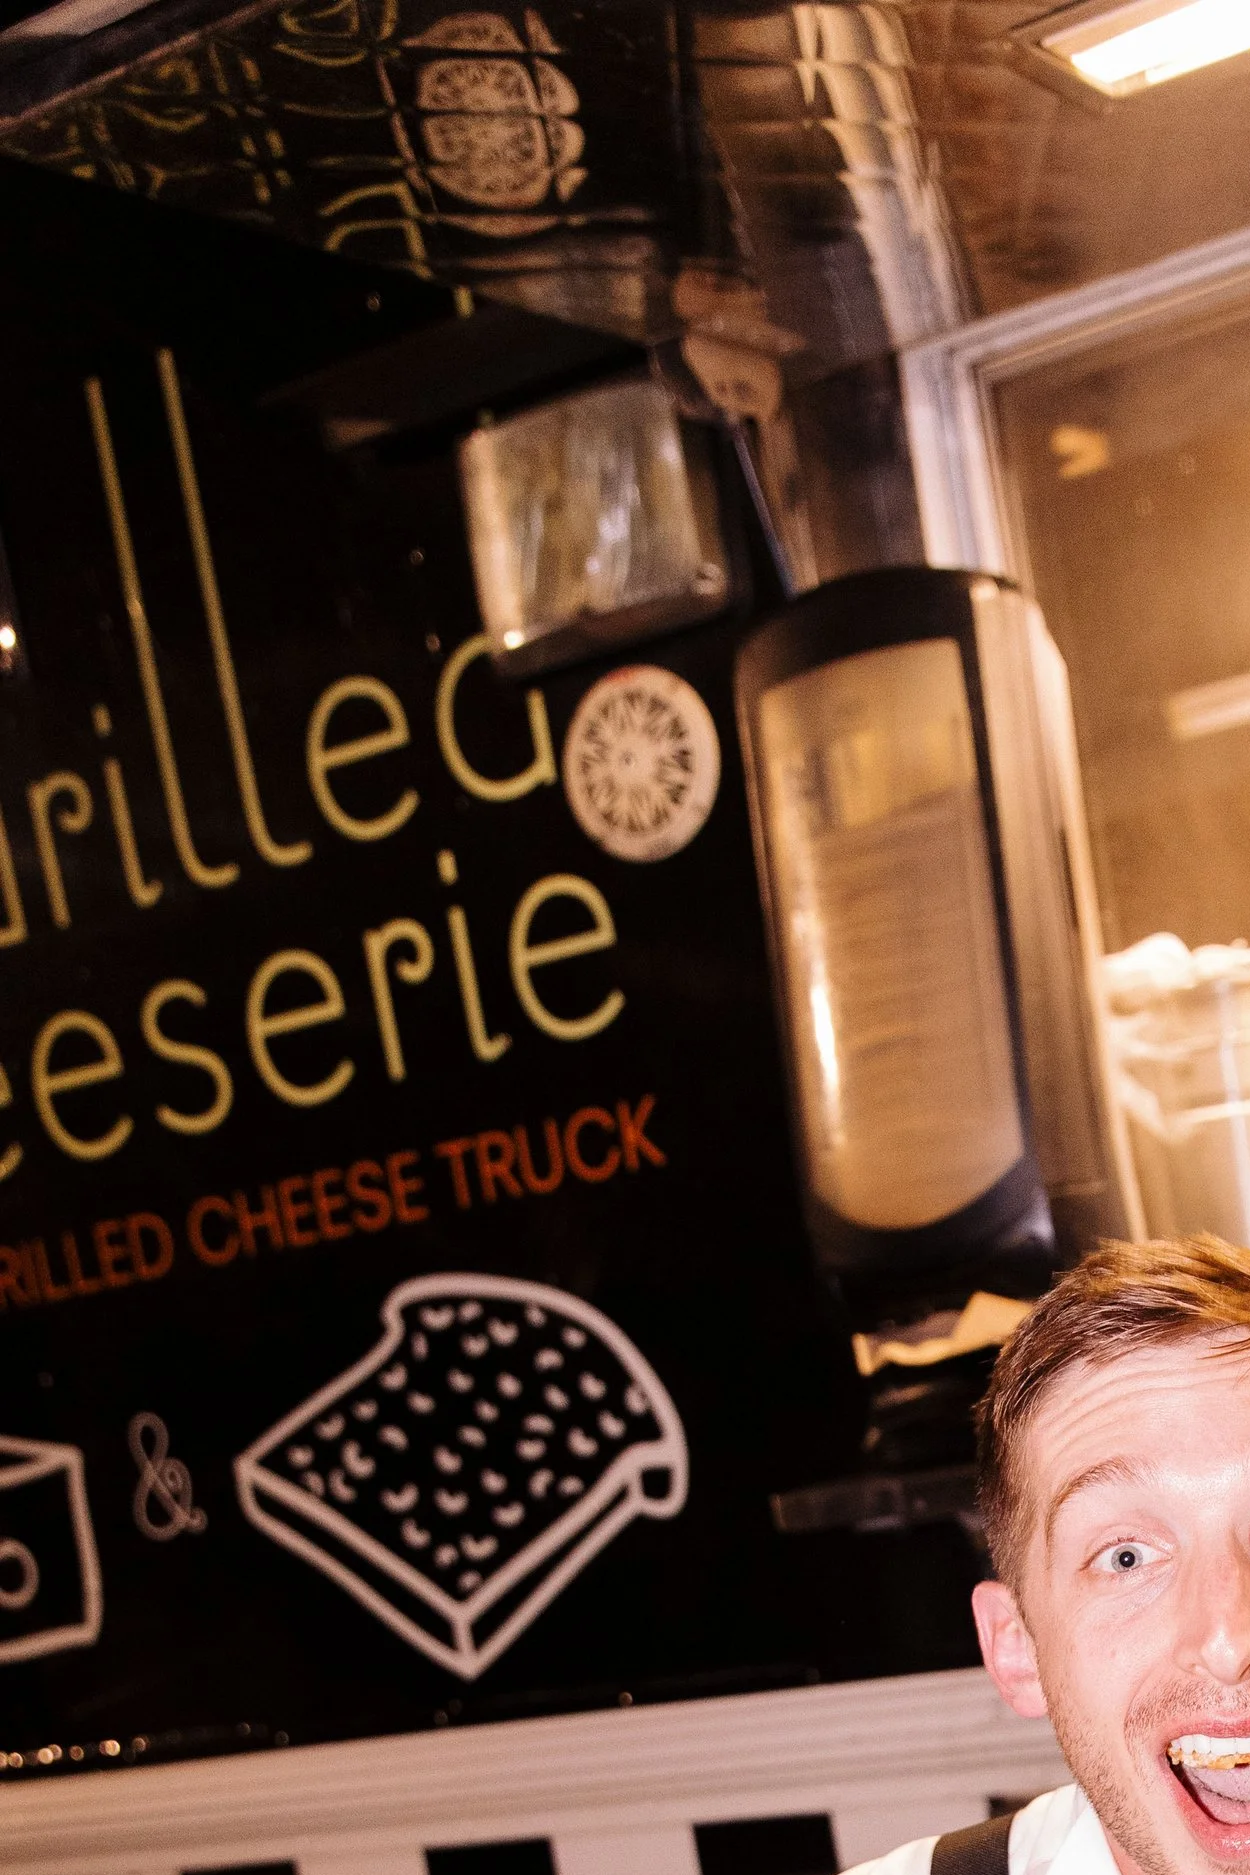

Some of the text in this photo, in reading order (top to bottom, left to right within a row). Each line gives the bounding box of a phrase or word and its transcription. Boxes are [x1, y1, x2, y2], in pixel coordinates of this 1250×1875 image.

[187, 1151, 429, 1266] CHEESE
[434, 1096, 667, 1209] TRUCK
[128, 1411, 208, 1540] &
